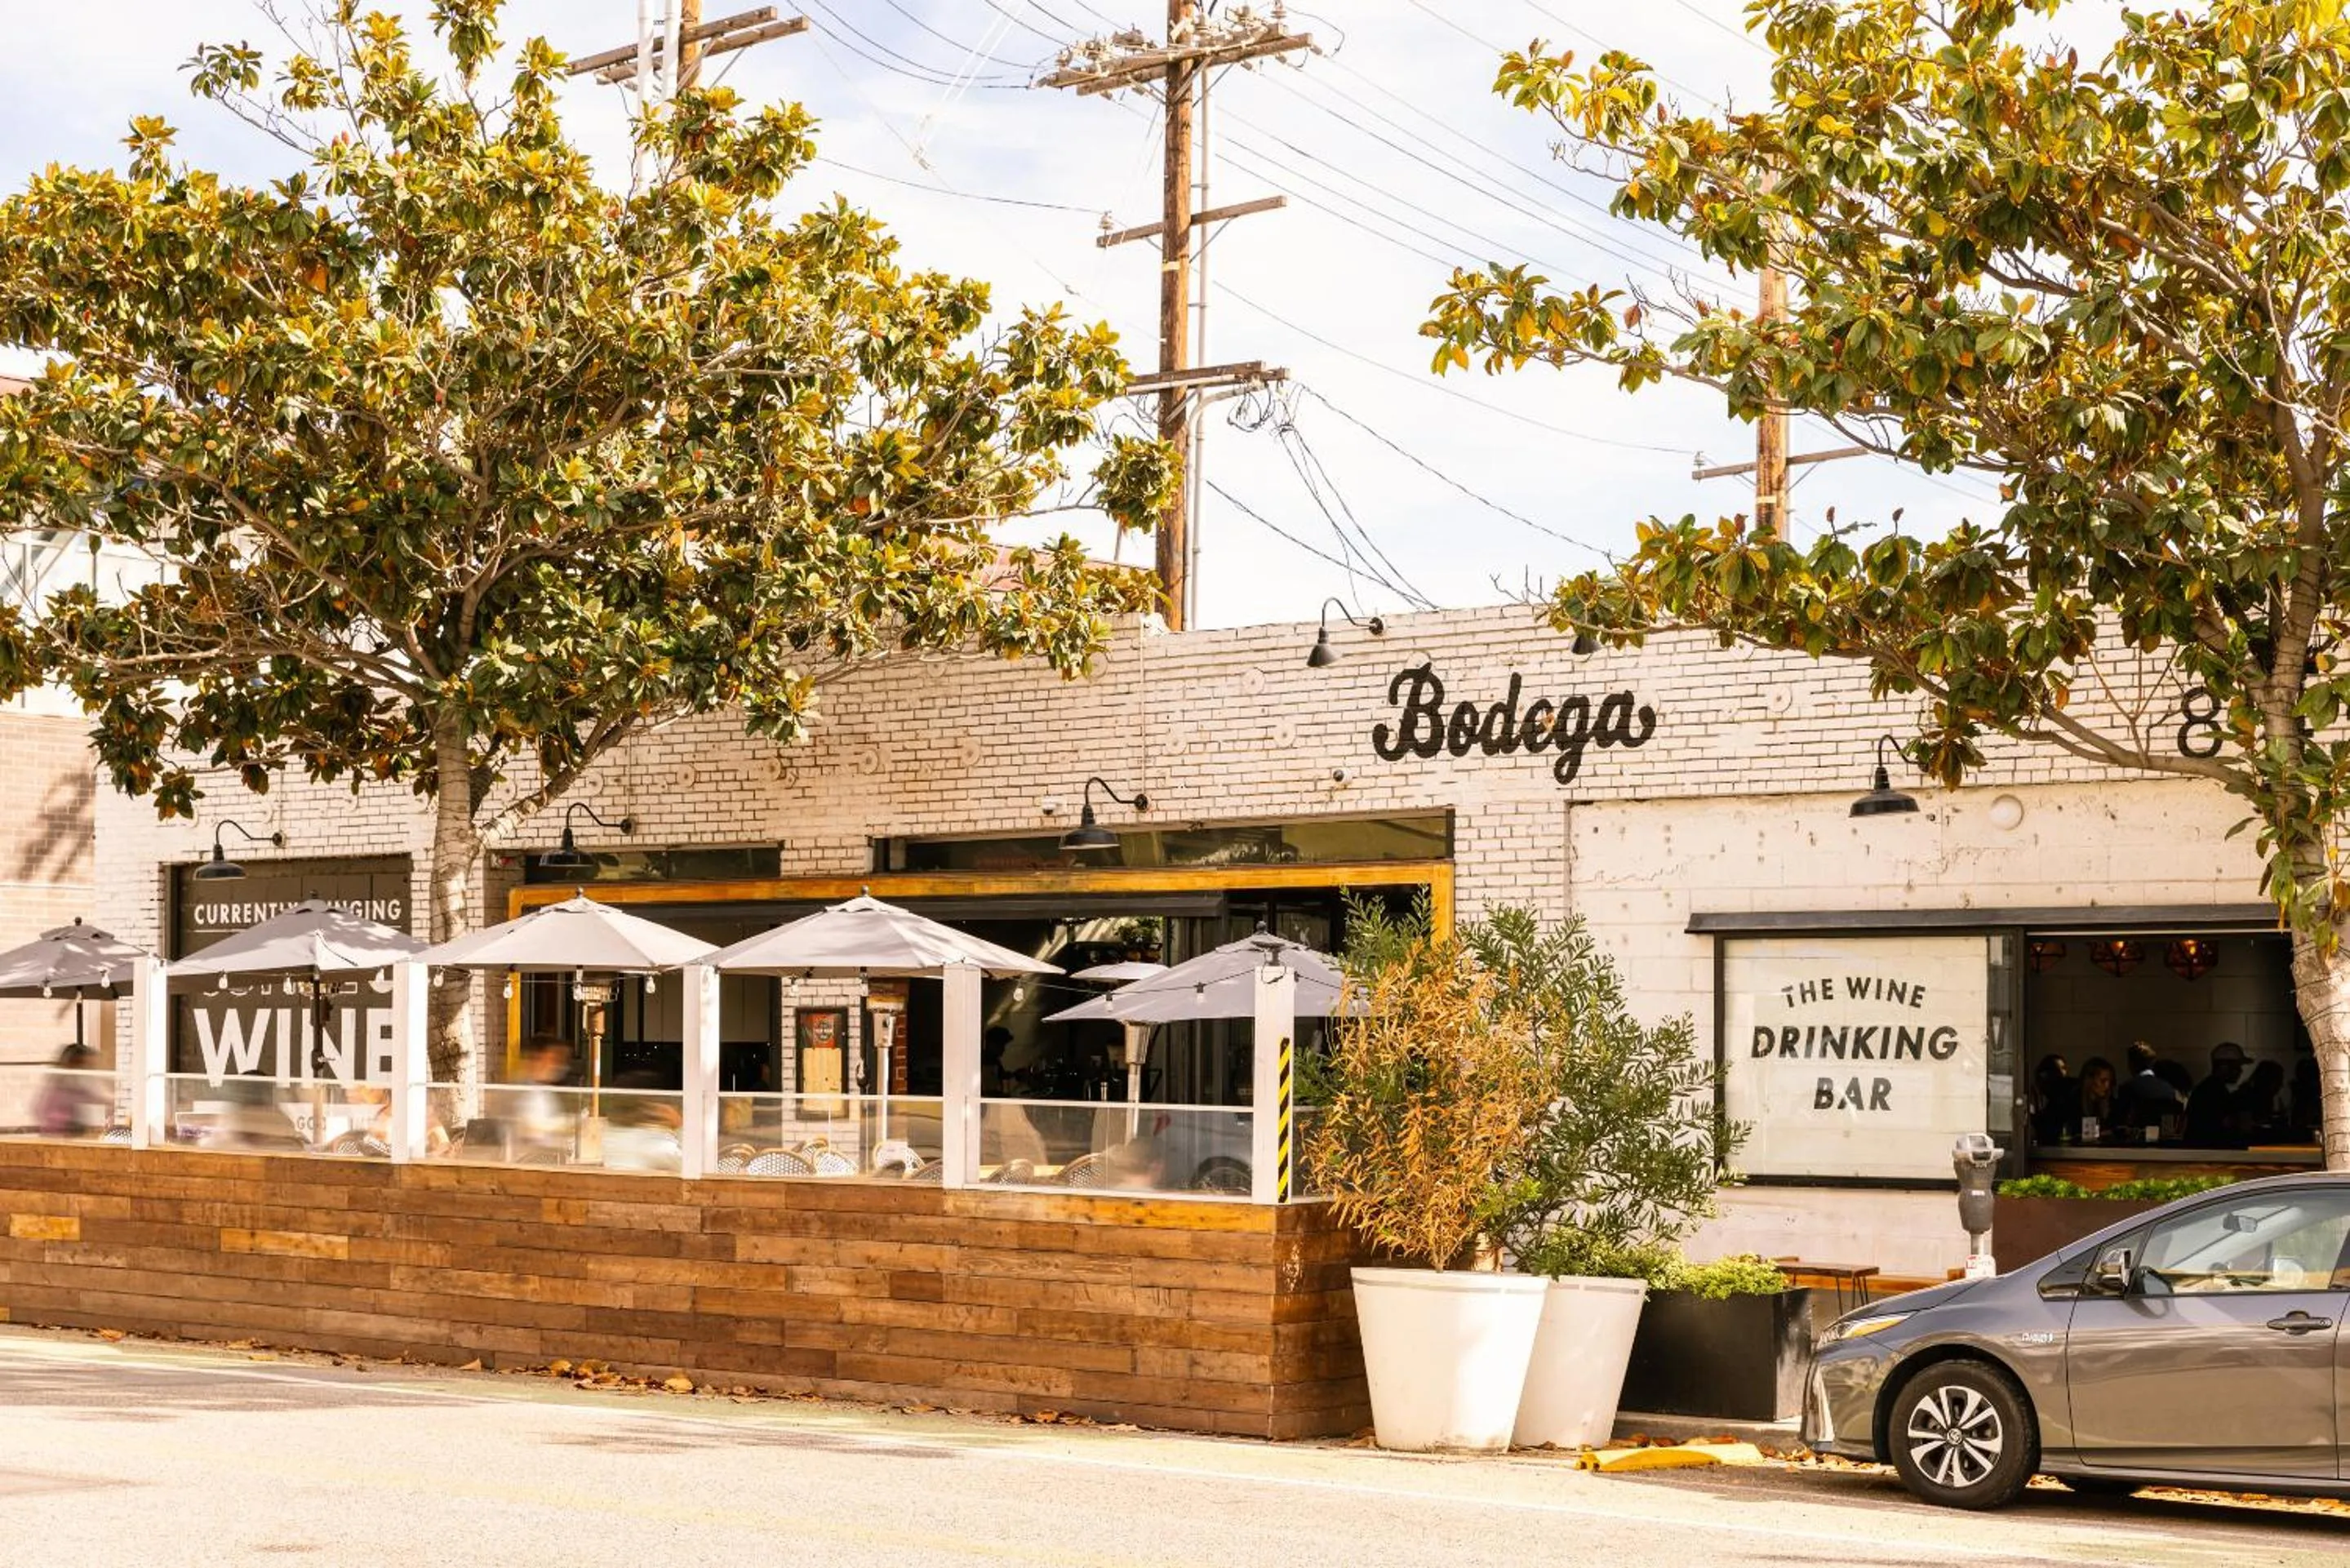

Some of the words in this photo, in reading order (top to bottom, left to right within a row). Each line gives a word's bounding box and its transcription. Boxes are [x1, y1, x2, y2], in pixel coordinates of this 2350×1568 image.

[1372, 662, 1656, 784] Bodega
[1781, 978, 1834, 1008] THE
[1846, 977, 1926, 1008] WINE
[1751, 1025, 1958, 1060] DRINKING
[1814, 1077, 1892, 1111] BAR
